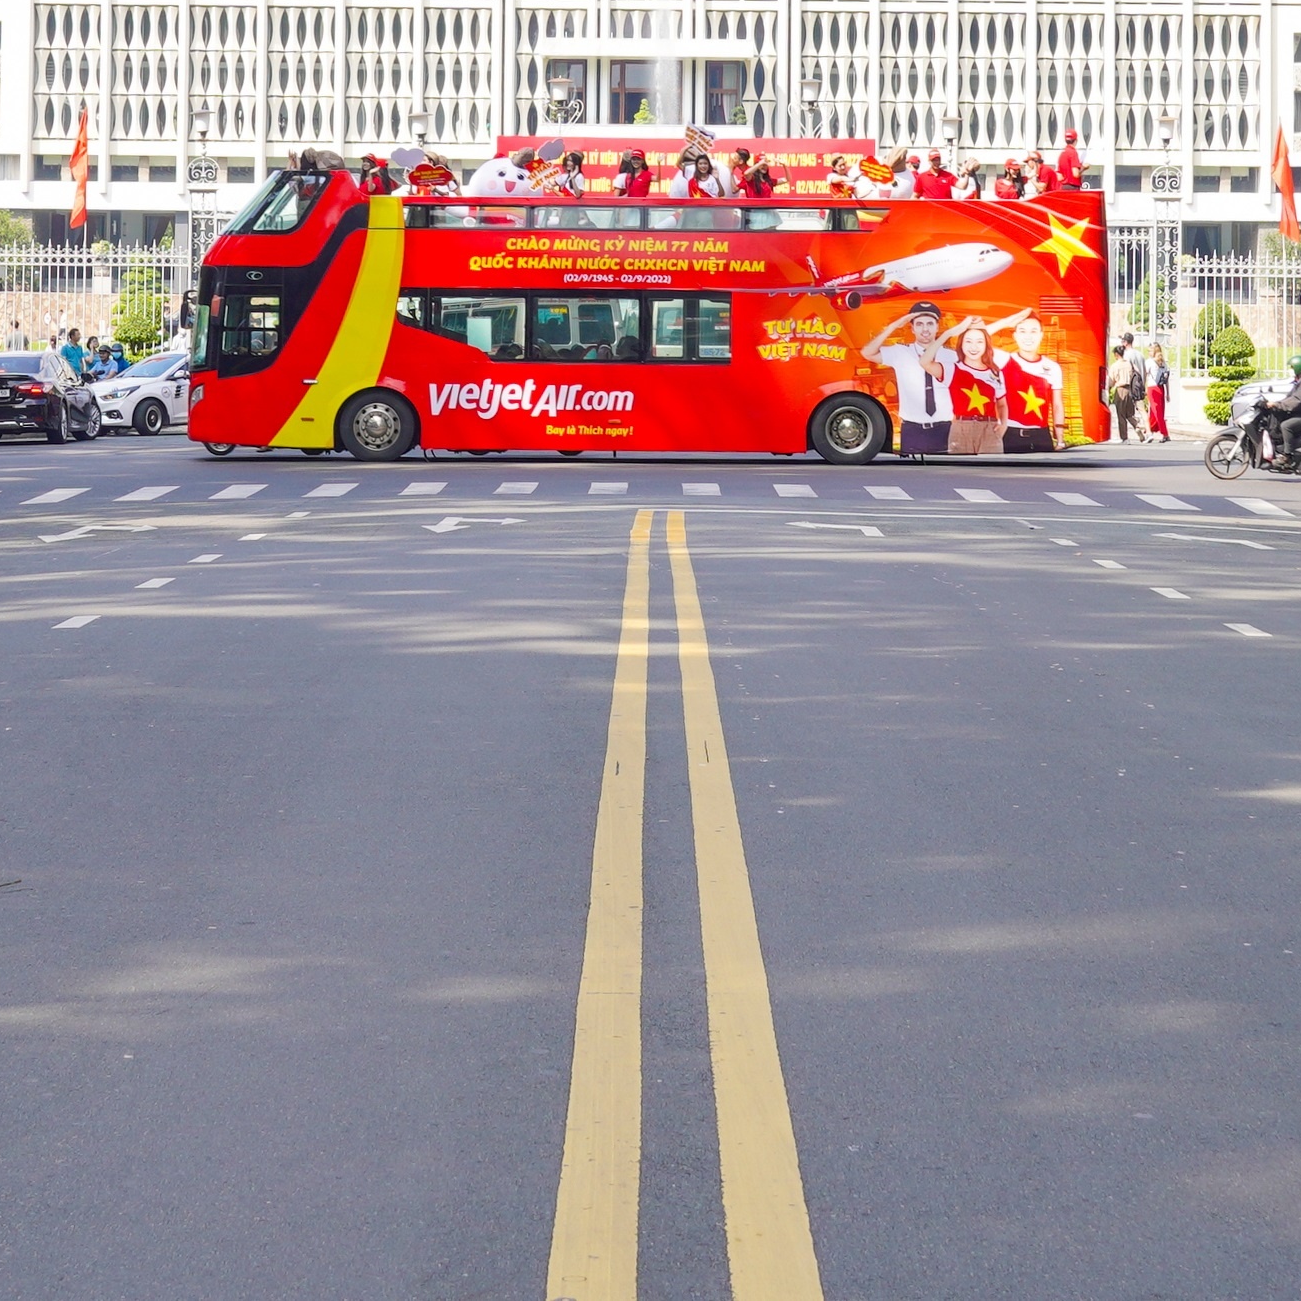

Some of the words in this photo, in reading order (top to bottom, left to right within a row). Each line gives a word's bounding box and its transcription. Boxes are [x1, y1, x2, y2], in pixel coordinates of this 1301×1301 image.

[505, 235, 551, 251] CHÀO
[553, 235, 601, 252] MỪNG
[604, 235, 625, 251] KỶ
[628, 237, 668, 255] NIỆM
[671, 240, 689, 252] 77
[692, 237, 729, 253] NĂM
[469, 252, 514, 271] QUỐC
[517, 254, 573, 270] KHÁNH
[575, 254, 621, 270] NƯỚC
[623, 258, 689, 272] CHXHCN
[692, 256, 726, 275] VIỆT
[729, 260, 765, 273] NAM
[563, 273, 614, 284] (02/9/1945
[620, 273, 672, 285] 02/9/2022)
[763, 317, 794, 338] TỰ
[796, 316, 842, 337] HÀO
[757, 340, 800, 361] VIỆT
[802, 343, 847, 361] NAM
[546, 424, 565, 437] Bay
[566, 424, 576, 435] là
[578, 425, 604, 435] Thích
